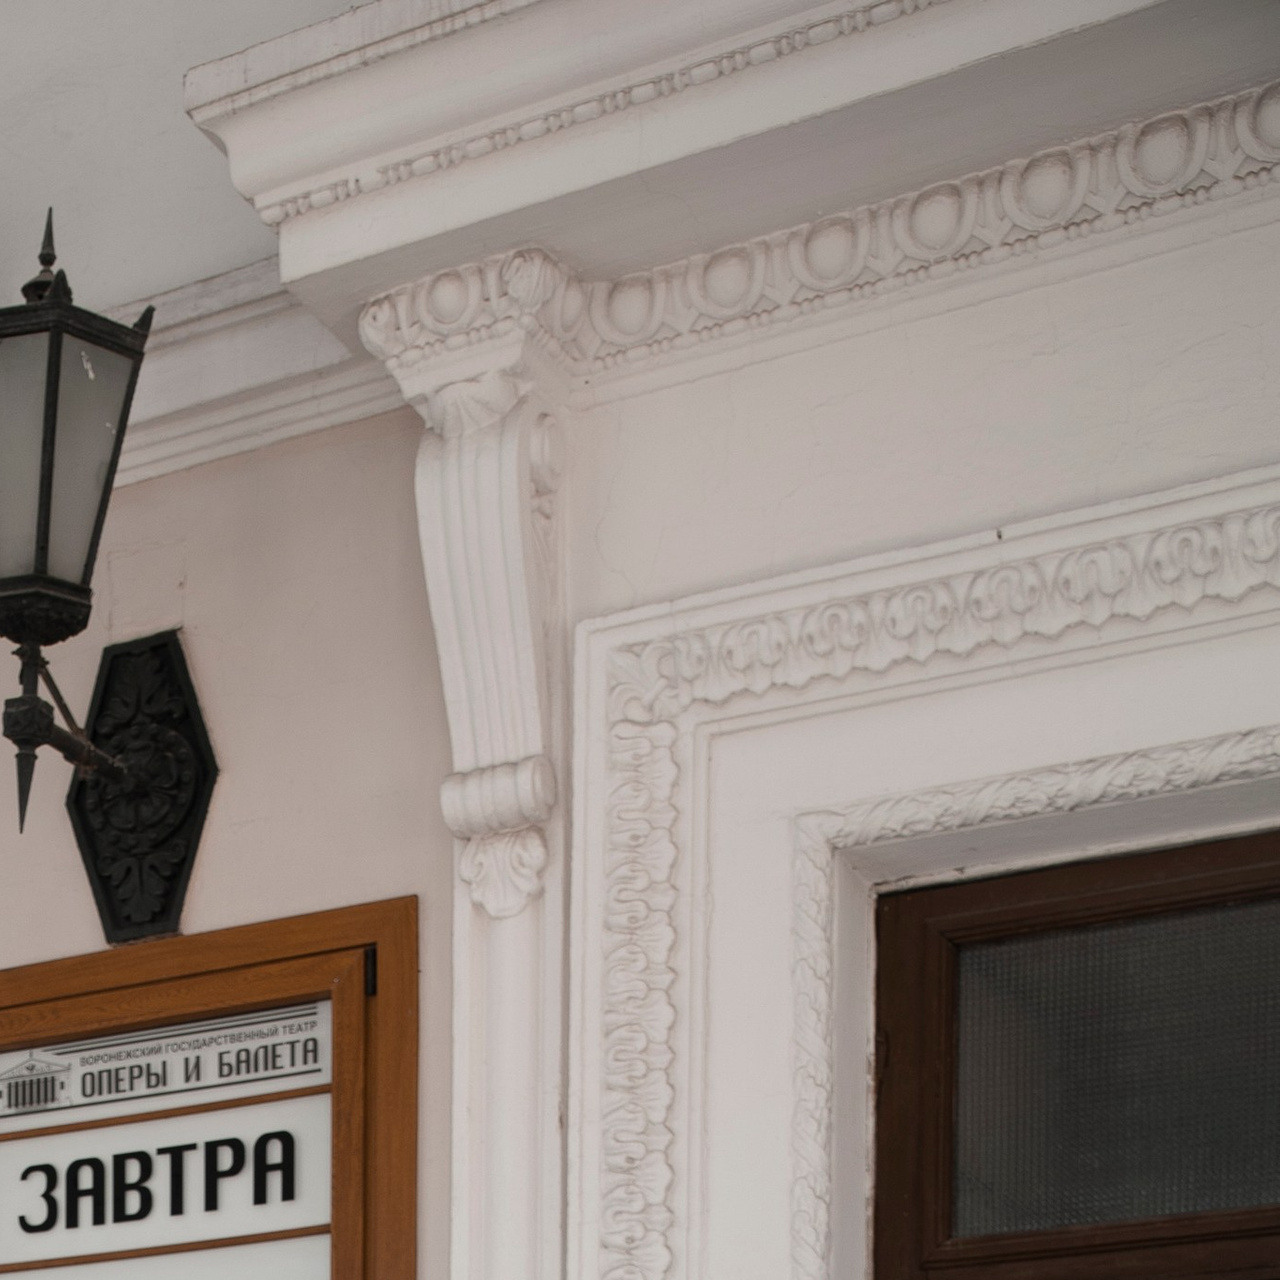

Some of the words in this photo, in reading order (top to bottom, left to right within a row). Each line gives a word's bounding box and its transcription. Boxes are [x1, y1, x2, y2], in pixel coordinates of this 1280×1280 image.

[80, 1043, 163, 1067] ВОРОНЕЖСКИЙ
[165, 1026, 280, 1054] ГОСУДАРСТВЕННЫЙ
[282, 1020, 318, 1035] ТЕАТР
[81, 1060, 167, 1098] ОПЕРЫ
[184, 1055, 201, 1083] И
[218, 1037, 319, 1078] БАЛЕТА
[18, 1130, 296, 1234] ЗАВТРА
